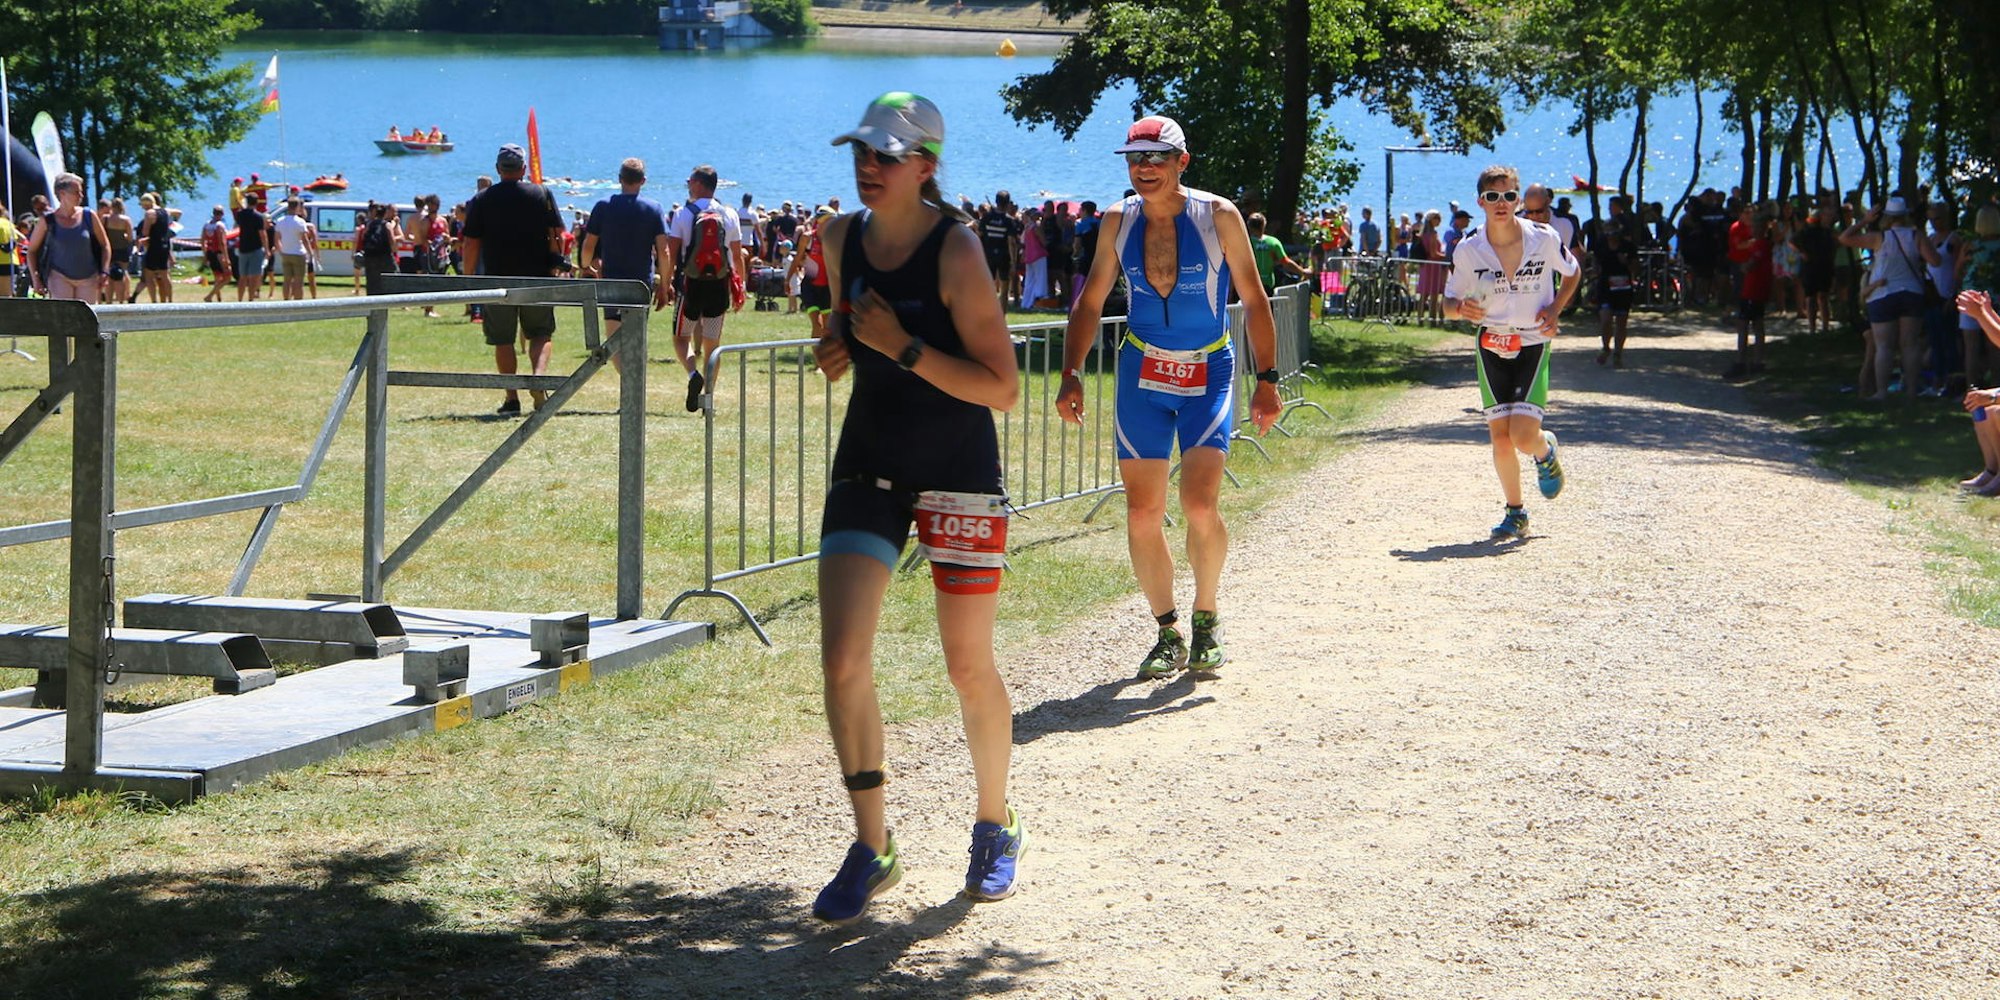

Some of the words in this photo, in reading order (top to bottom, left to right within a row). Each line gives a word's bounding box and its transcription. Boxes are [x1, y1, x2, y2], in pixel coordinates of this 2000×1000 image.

[1154, 361, 1196, 379] 1167
[929, 514, 992, 539] 1056
[508, 683, 535, 699] ENGELEN
